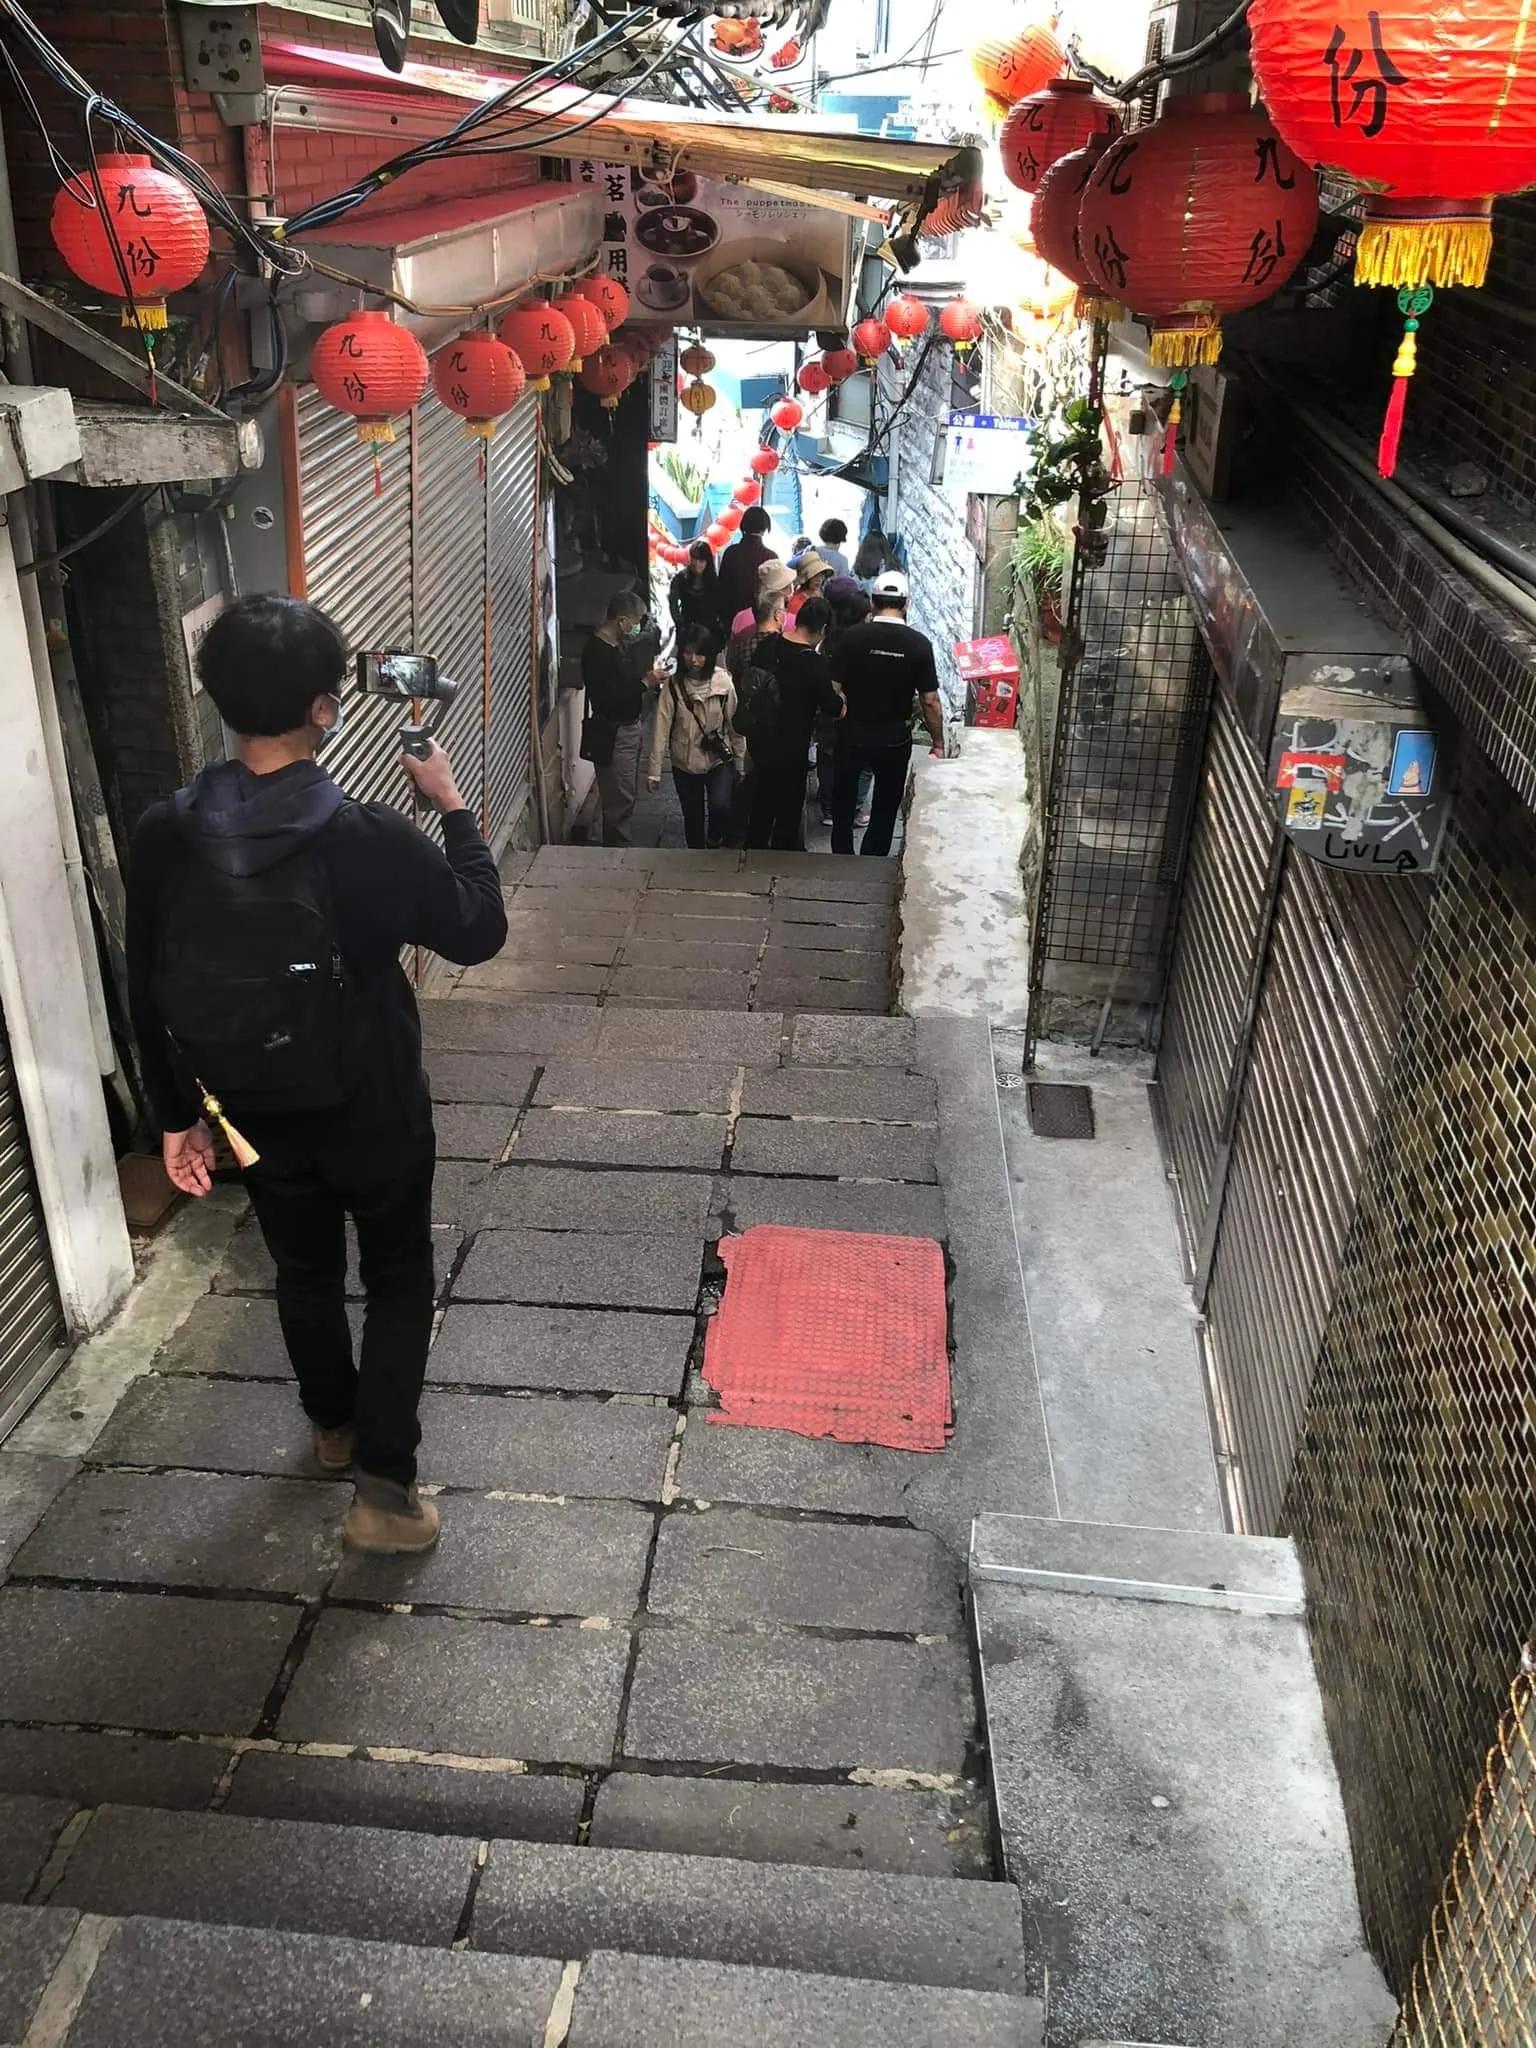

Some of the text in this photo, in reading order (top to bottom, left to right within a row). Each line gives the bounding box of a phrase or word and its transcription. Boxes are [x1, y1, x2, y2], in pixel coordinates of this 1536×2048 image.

[1323, 10, 1410, 138] 份
[1013, 103, 1042, 182] 九份
[117, 184, 161, 278] 九份
[1096, 141, 1138, 289] 九份
[1241, 136, 1296, 287] 九份
[338, 333, 368, 402] 九份
[448, 351, 469, 409] 九份
[540, 322, 558, 370] 九份
